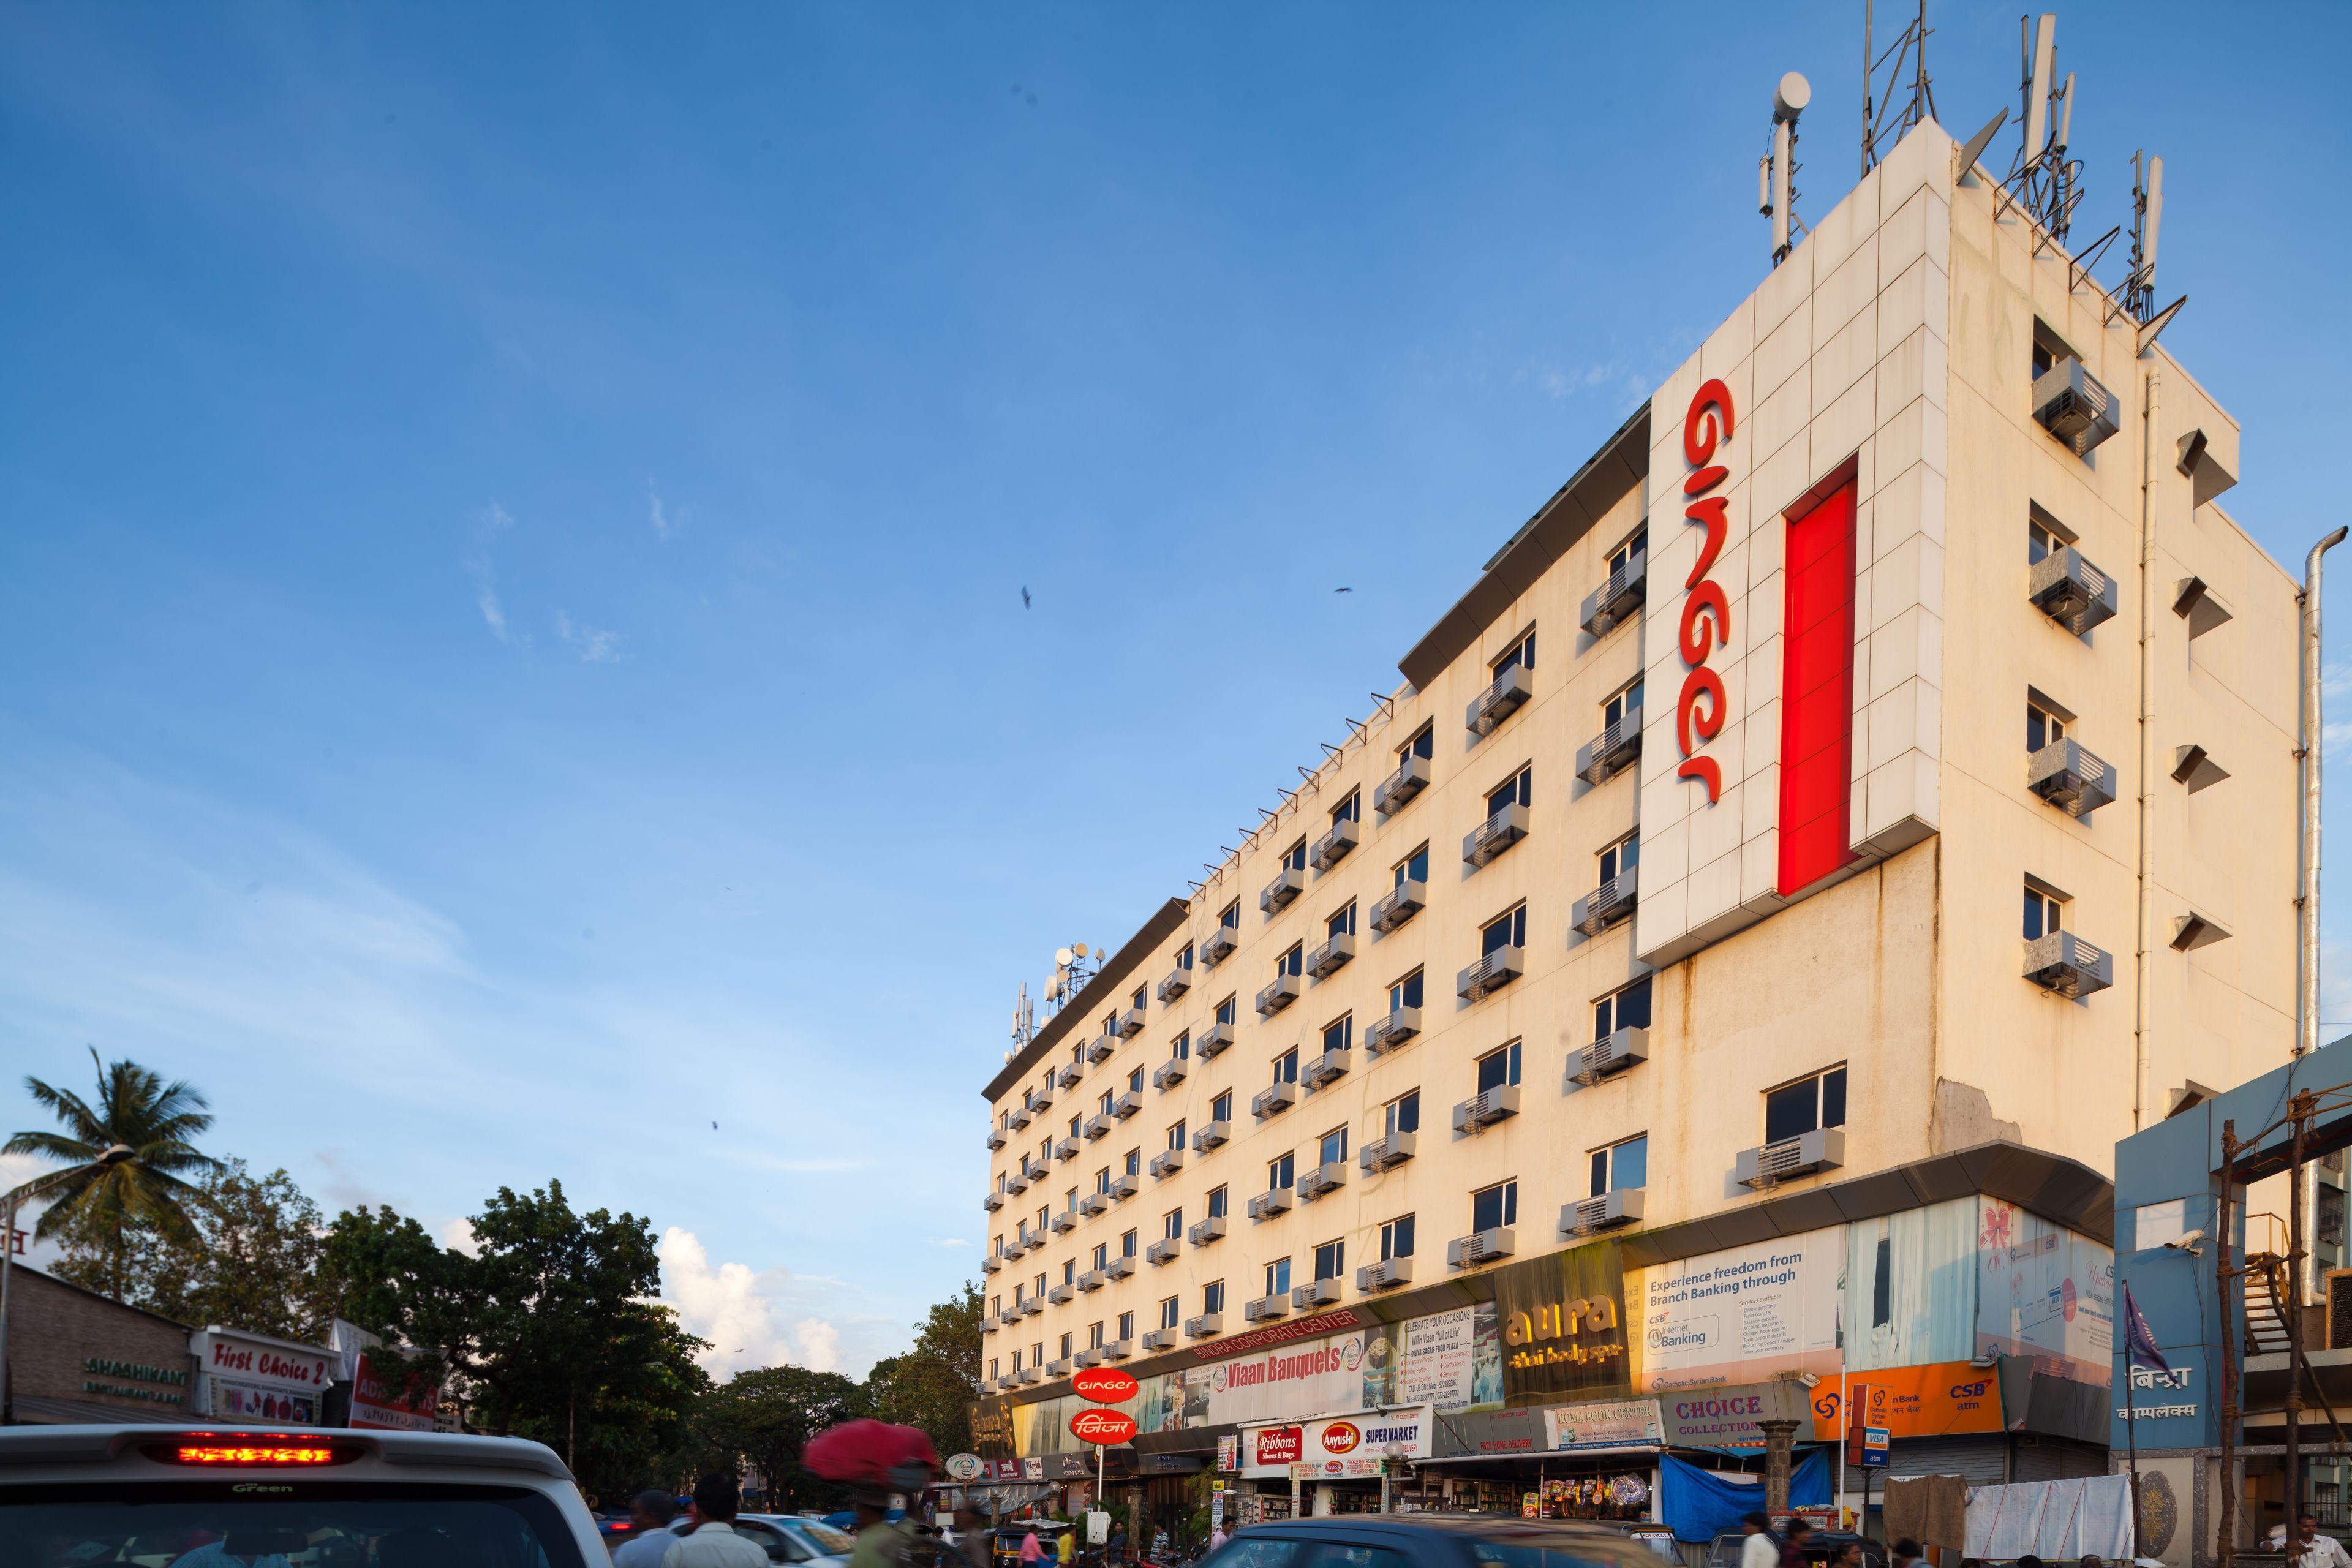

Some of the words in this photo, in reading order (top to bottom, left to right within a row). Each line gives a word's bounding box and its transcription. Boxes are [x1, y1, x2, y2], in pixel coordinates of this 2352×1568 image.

[1651, 1273, 1711, 1292] Experience
[1714, 1262, 1766, 1279] freedom
[1770, 1253, 1802, 1268] from
[1650, 1291, 1688, 1306] Branch
[1691, 1281, 1739, 1299] Banking
[1743, 1268, 1795, 1288] through
[1404, 1319, 1428, 1333] CELEBRATE
[1430, 1316, 1442, 1327] YOUR
[1443, 1310, 1470, 1325] OCCASIONS
[1506, 1294, 1616, 1346] aura
[1649, 1315, 1665, 1324] CSB
[1194, 1340, 1232, 1359] BINDRA
[1232, 1324, 1303, 1351] CORPORATE
[1300, 1310, 1359, 1333] CENTER
[1412, 1335, 1422, 1346] WITH
[1423, 1333, 1434, 1343] Viaan
[1445, 1329, 1449, 1339] of
[1662, 1325, 1688, 1335] Internet
[1662, 1332, 1706, 1347] Banking
[1411, 1349, 1422, 1357] DIVYA
[1422, 1346, 1434, 1355] SAGAR
[1446, 1341, 1458, 1351] PLAZA
[1513, 1350, 1544, 1369] thai
[1547, 1344, 1588, 1365] body
[1589, 1344, 1619, 1363] spa
[85, 1358, 189, 1385] SHASHIKANT
[214, 1344, 252, 1371] First
[259, 1352, 309, 1381] Choice
[313, 1362, 325, 1384] 2
[1228, 1362, 1265, 1389] Viaan
[1268, 1346, 1340, 1383] Banquets
[1951, 1384, 1985, 1398] CSB
[1558, 1412, 1585, 1425] ROMA
[1585, 1409, 1613, 1423] BOOK
[1613, 1406, 1653, 1419] CENTER
[1676, 1396, 1764, 1419] CHOICE
[1076, 1414, 1133, 1434] जिंजर
[1679, 1422, 1758, 1434] COLLECTION
[1259, 1433, 1296, 1452] Ribbons
[1366, 1428, 1388, 1444] SUPER
[1389, 1425, 1419, 1442] MARKET
[1480, 1441, 1492, 1450] FREE
[1493, 1441, 1507, 1449] HOME
[1509, 1438, 1532, 1449] DELIVERY
[1870, 1434, 1884, 1443] VISA
[232, 1483, 293, 1493] Green
